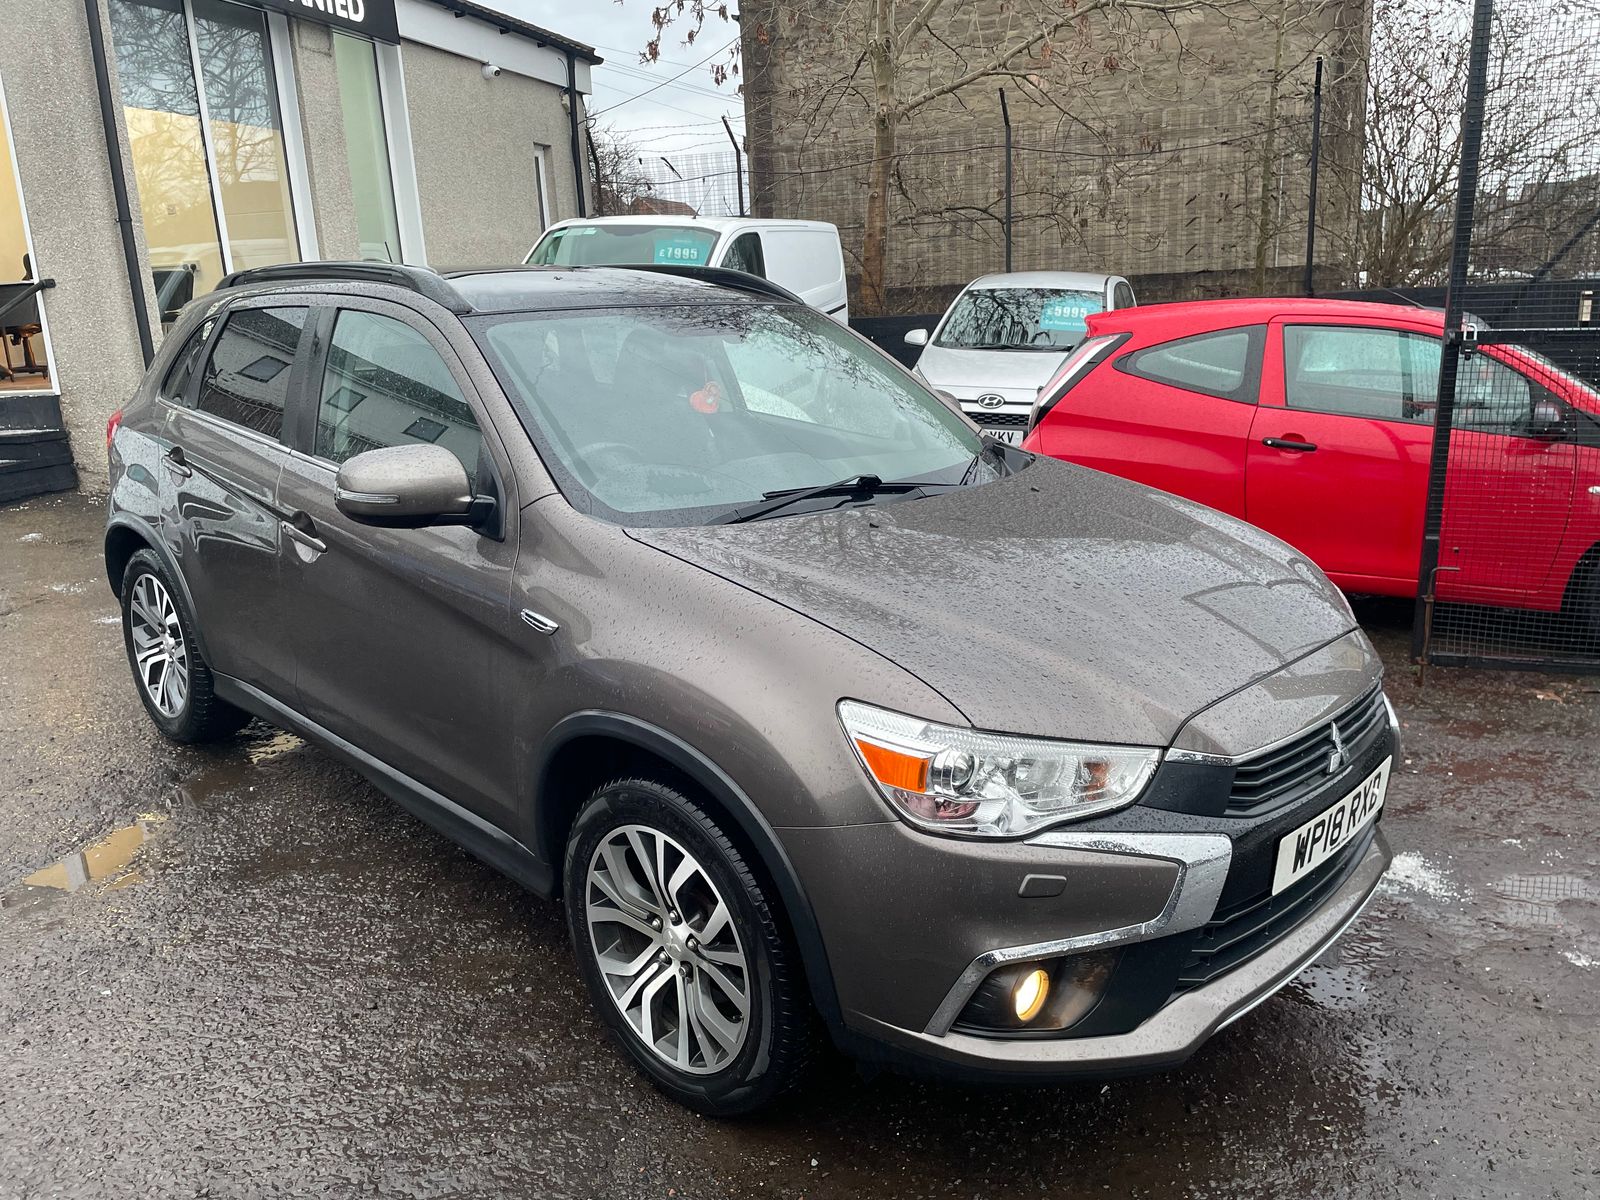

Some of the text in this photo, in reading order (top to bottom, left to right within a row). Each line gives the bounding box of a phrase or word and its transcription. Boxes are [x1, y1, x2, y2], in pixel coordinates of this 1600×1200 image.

[659, 247, 698, 260] £7995
[1047, 306, 1088, 319] £5995
[1292, 804, 1346, 874] WP18
